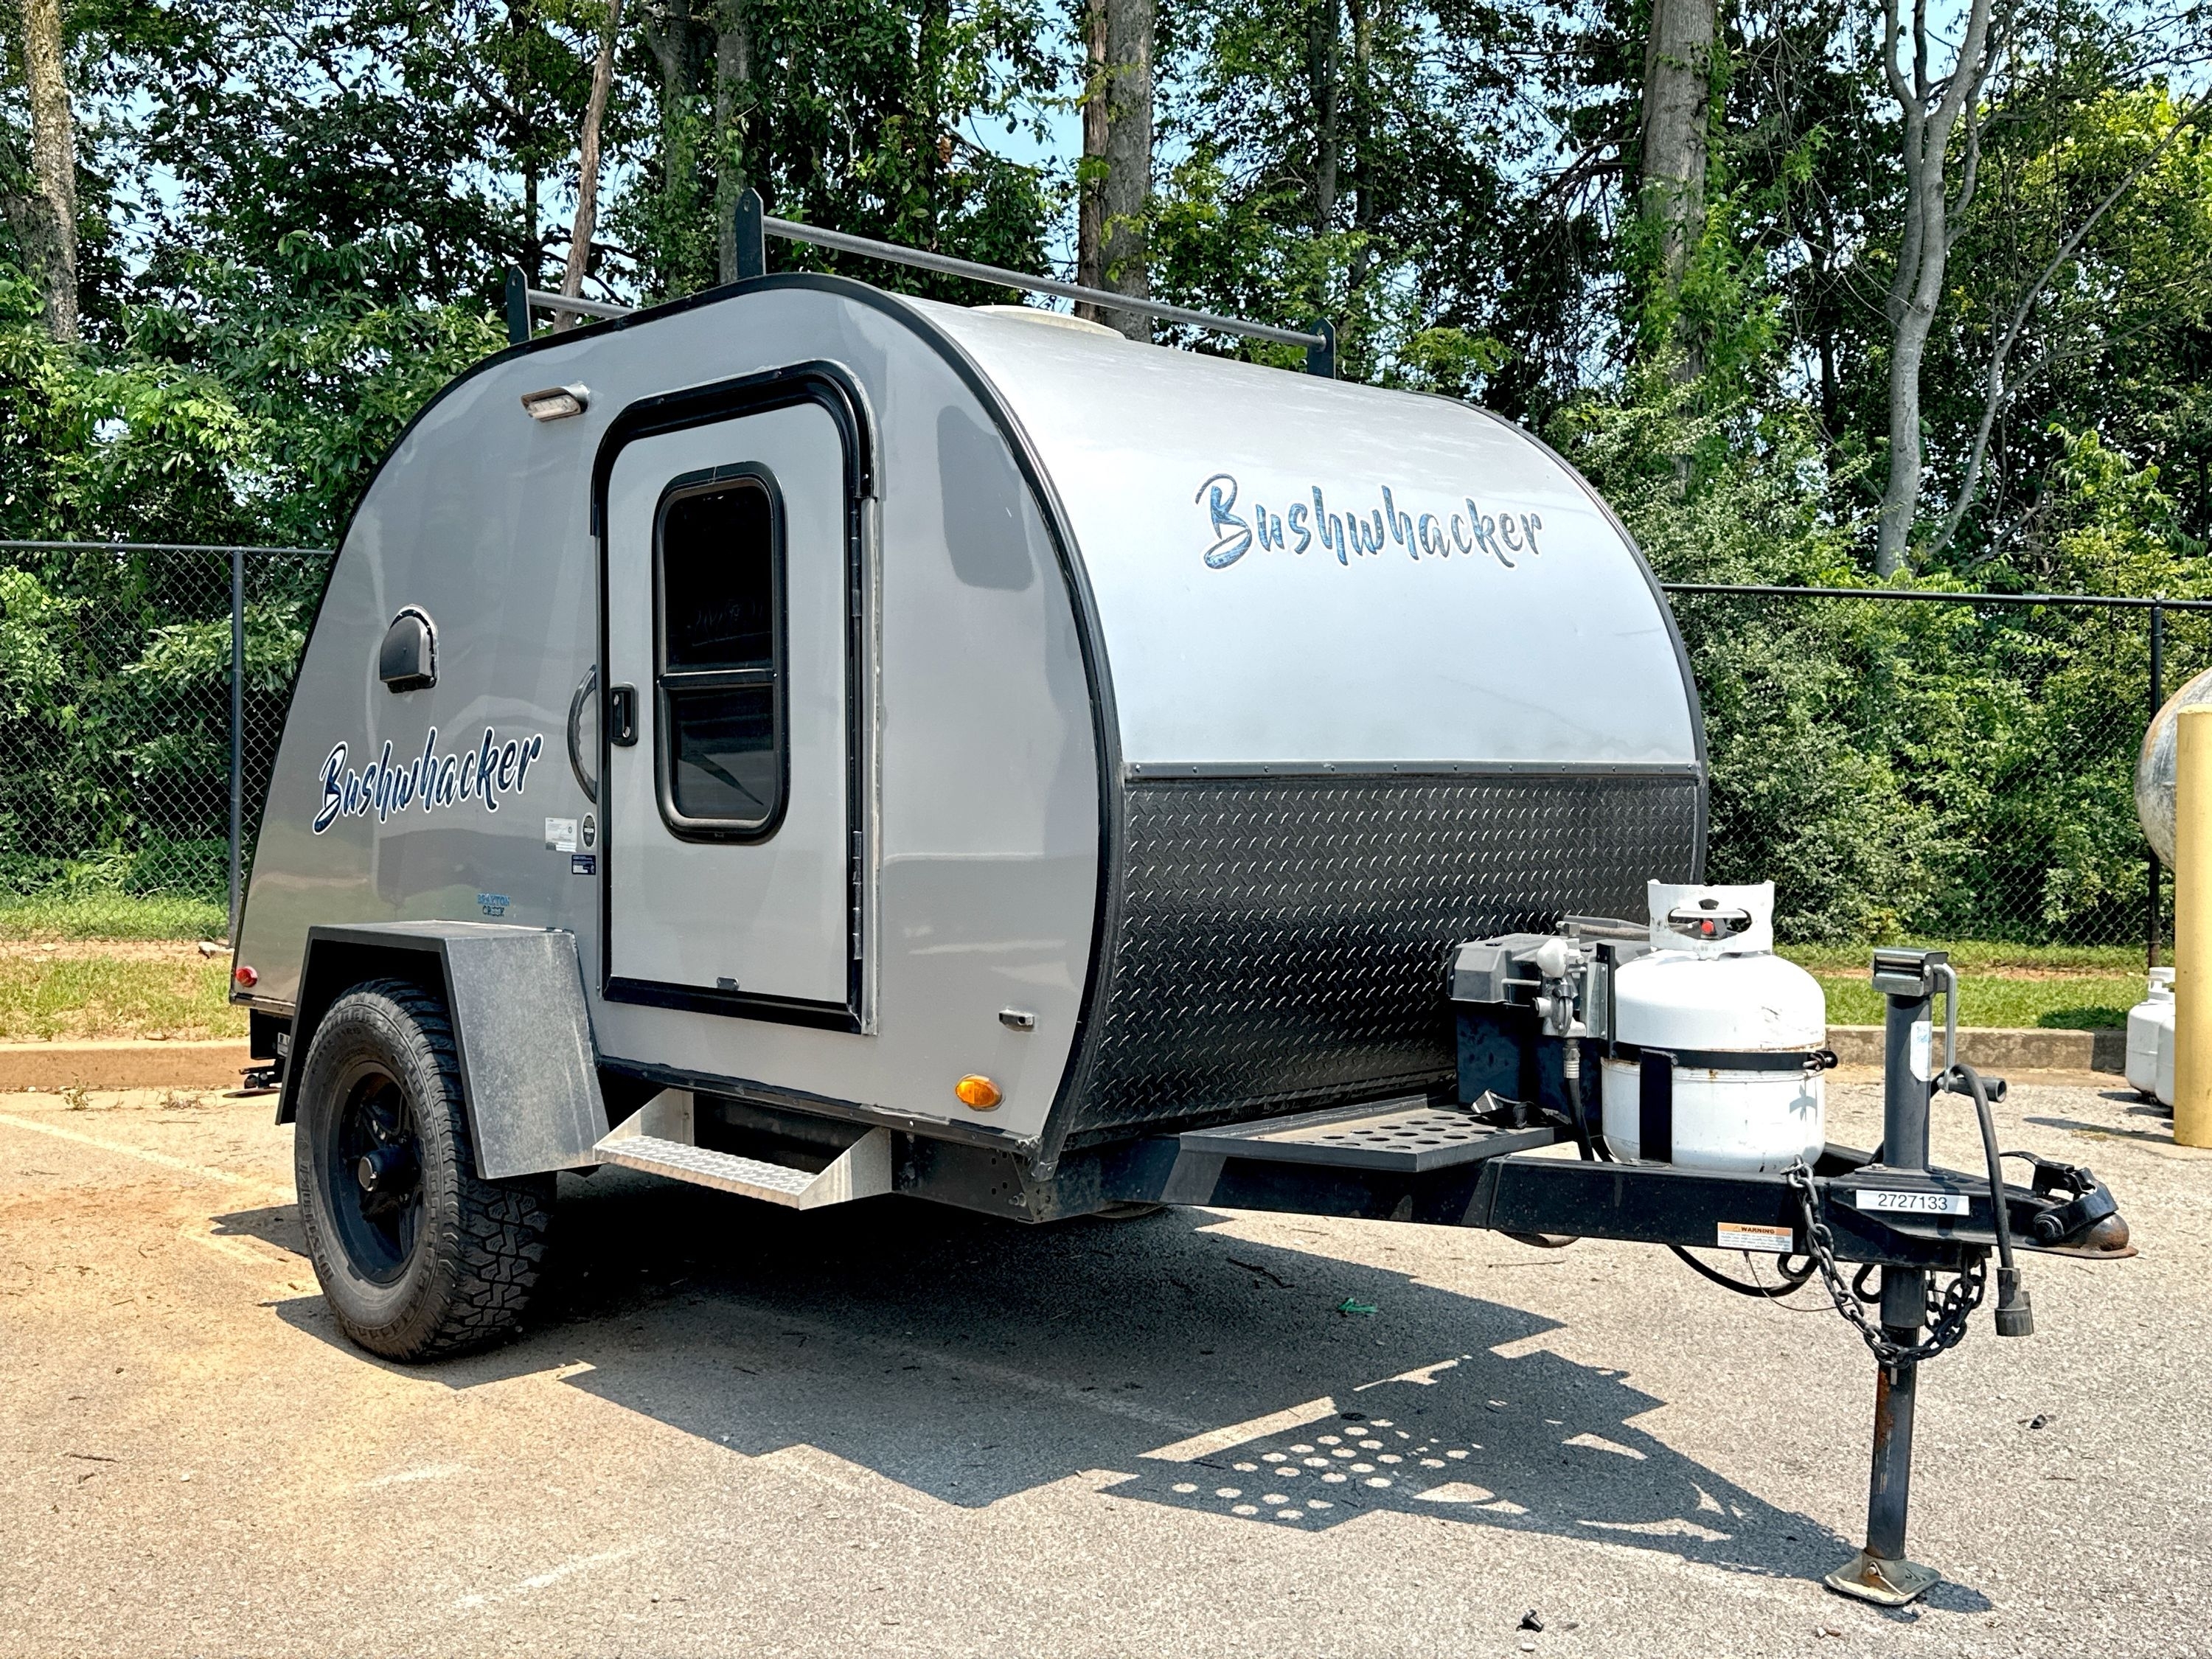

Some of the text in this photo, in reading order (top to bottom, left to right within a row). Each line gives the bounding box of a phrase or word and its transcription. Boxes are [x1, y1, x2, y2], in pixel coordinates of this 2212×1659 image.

[1194, 473, 1543, 570] Bushwhacker
[313, 726, 543, 835] Bushwhacker
[1740, 1226, 1775, 1234] WARNING
[1877, 1193, 1948, 1211] 2727133
